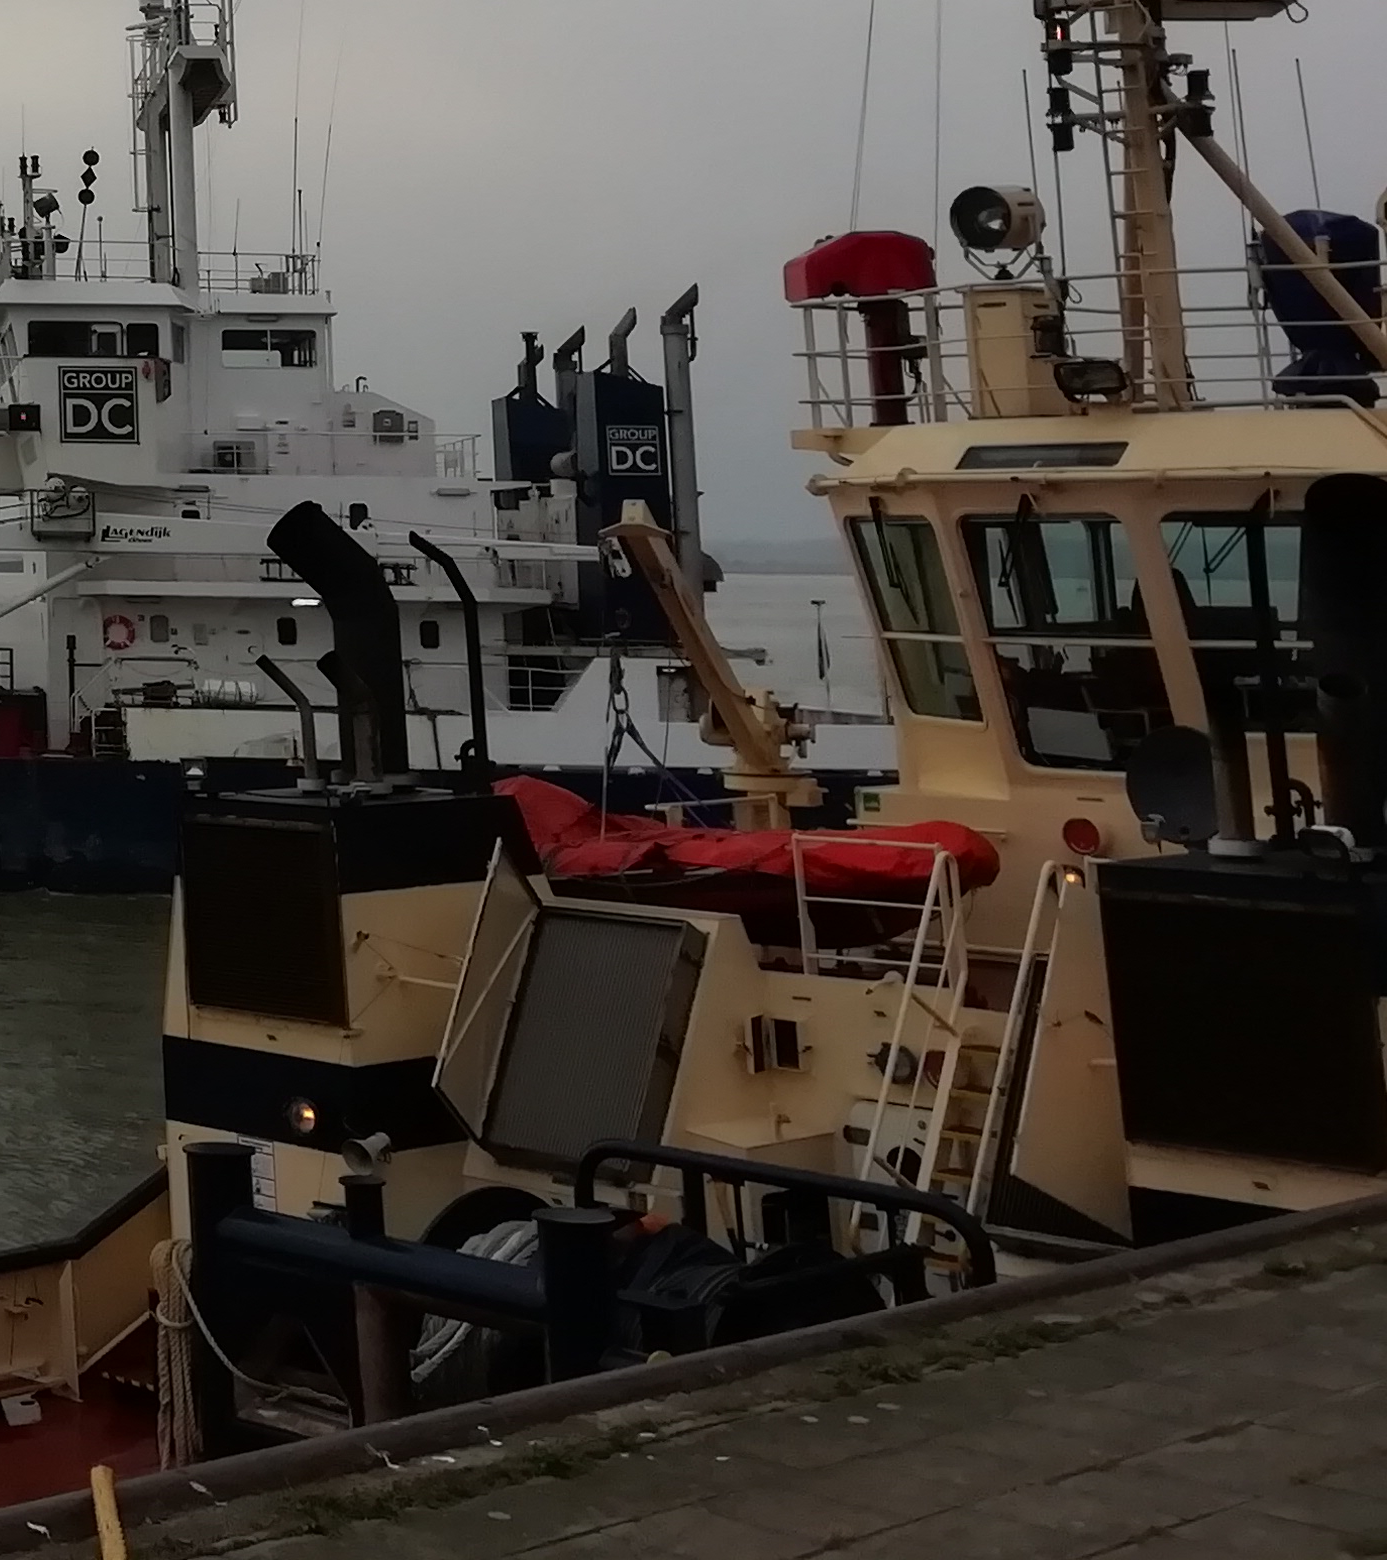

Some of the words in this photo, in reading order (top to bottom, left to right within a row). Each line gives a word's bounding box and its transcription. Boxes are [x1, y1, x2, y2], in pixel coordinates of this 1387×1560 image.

[64, 372, 133, 388] GROUP
[65, 397, 133, 435] DC
[609, 428, 657, 440] GROUP
[611, 445, 657, 471] DC
